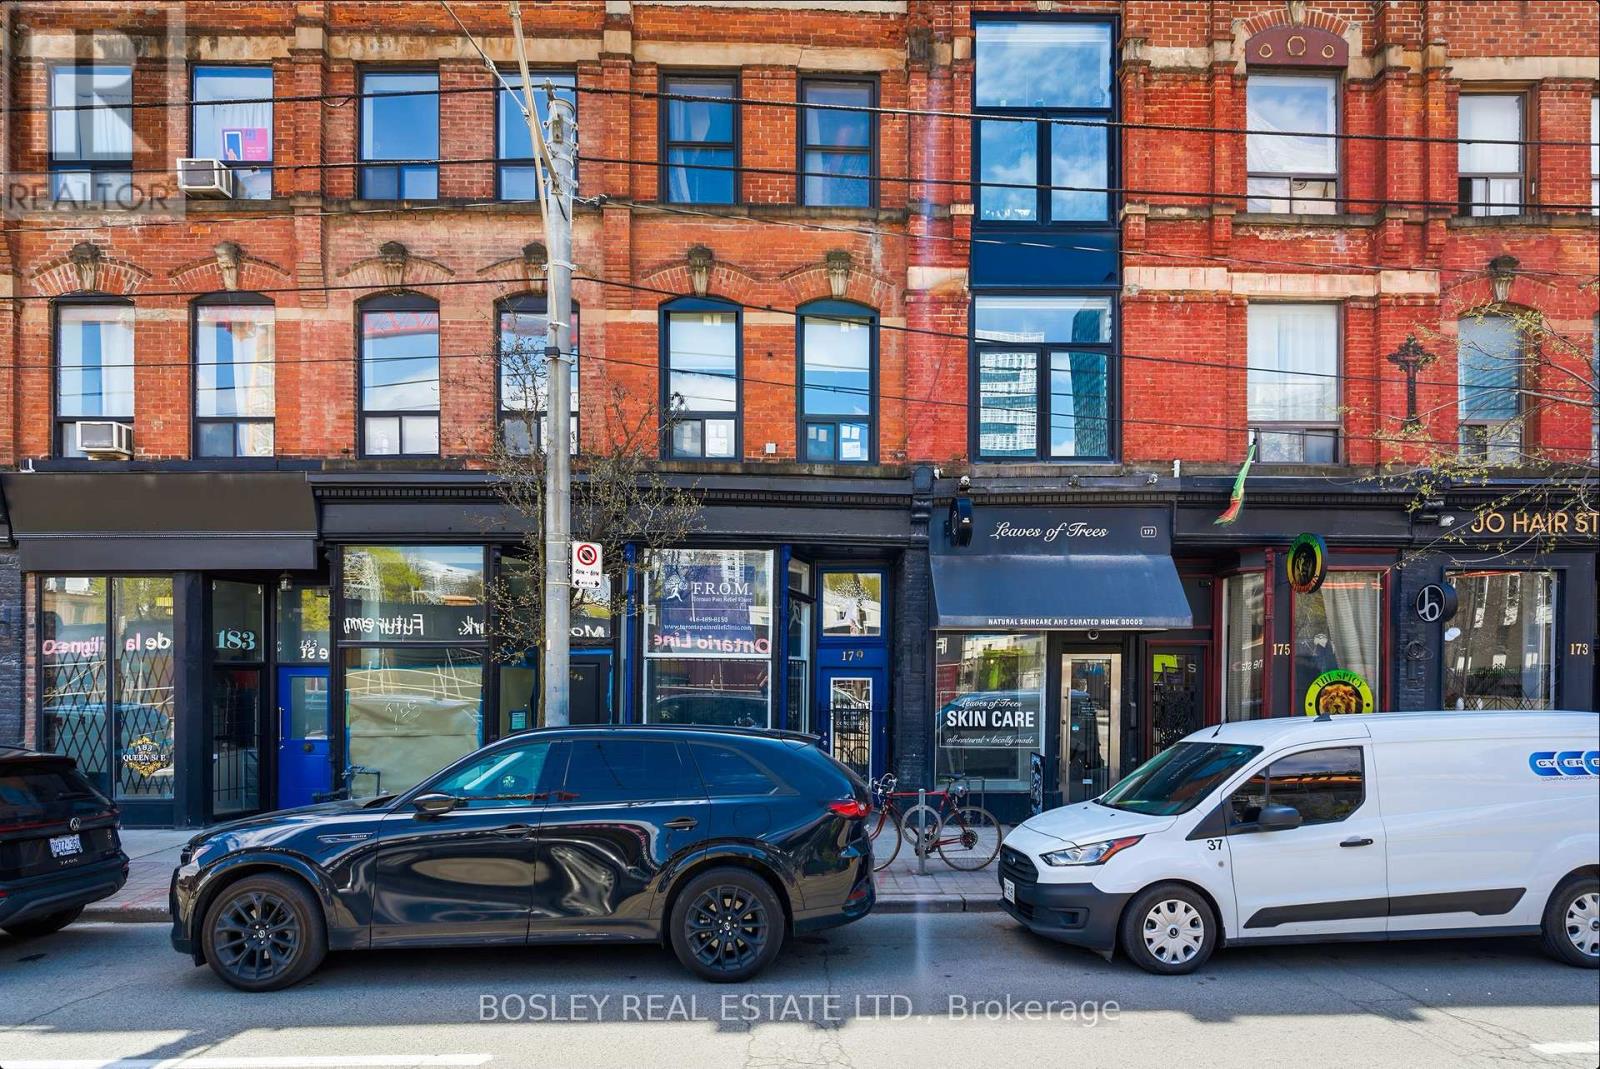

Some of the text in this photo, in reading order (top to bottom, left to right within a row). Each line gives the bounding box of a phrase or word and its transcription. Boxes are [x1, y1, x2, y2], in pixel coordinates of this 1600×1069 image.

[1471, 512, 1505, 533] JO
[1512, 512, 1568, 534] HAIR
[990, 521, 1109, 542] Leaves of Trees
[1143, 528, 1155, 536] 177
[693, 582, 753, 596] F.R.O.M.
[988, 618, 1143, 626] NATURAL SKINCARE AND CURATED HOME GOODS
[216, 629, 256, 650] 183
[1273, 643, 1291, 656] 175
[1570, 643, 1588, 655] 173
[959, 698, 1022, 710] Leaves of Trees
[946, 710, 1035, 728] SKIN CARE
[990, 735, 1014, 747] locally
[1014, 736, 1035, 745] made
[122, 754, 149, 762] QUEEN
[1206, 838, 1223, 851] 37
